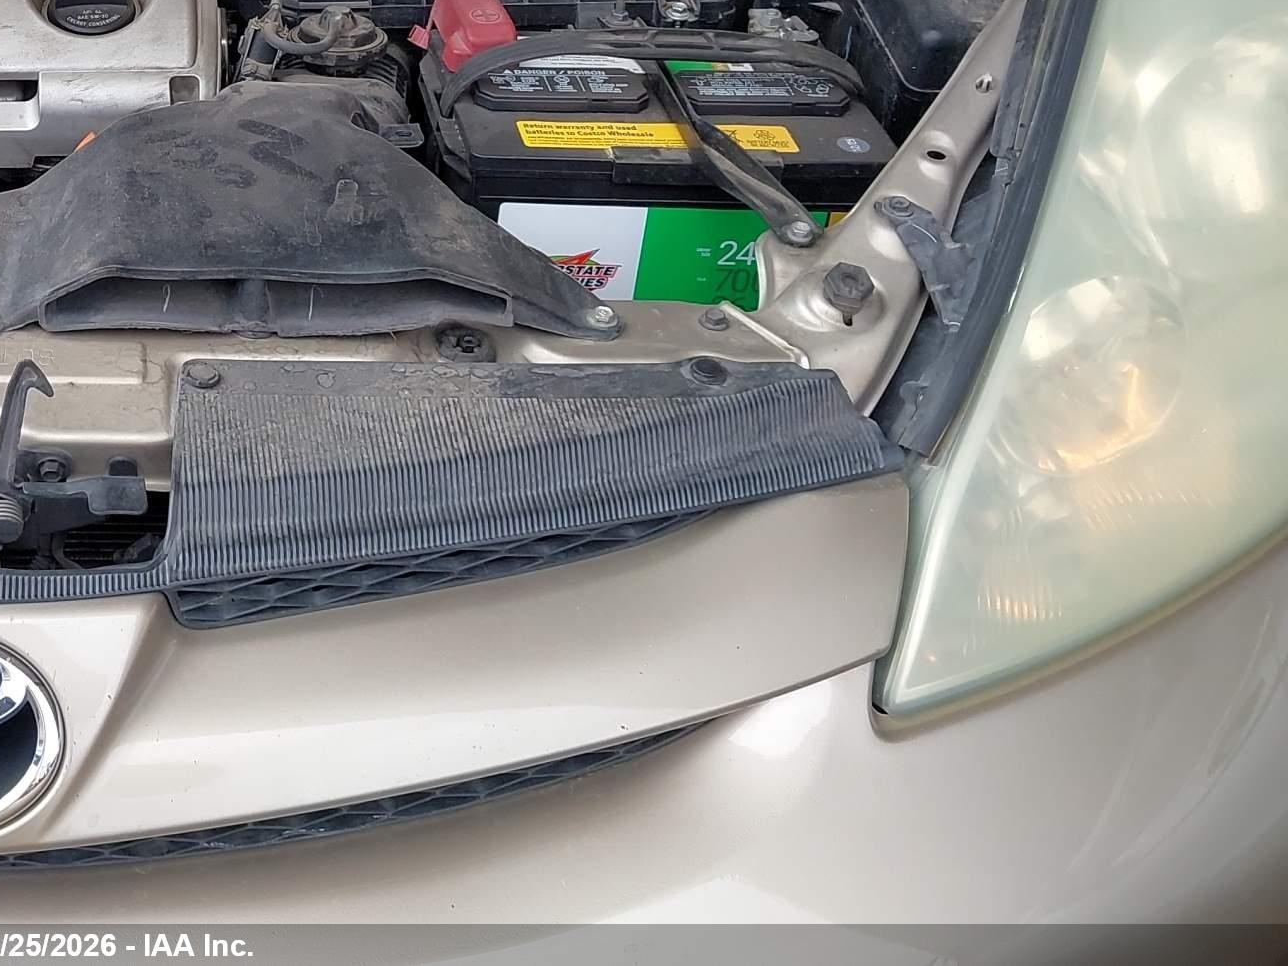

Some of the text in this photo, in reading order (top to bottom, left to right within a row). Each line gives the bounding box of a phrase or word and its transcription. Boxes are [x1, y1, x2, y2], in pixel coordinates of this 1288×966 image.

[523, 122, 554, 130] Return
[556, 123, 594, 131] warranty
[607, 130, 654, 138] Wholesale
[557, 265, 615, 276] STATE
[713, 268, 759, 293] 70
